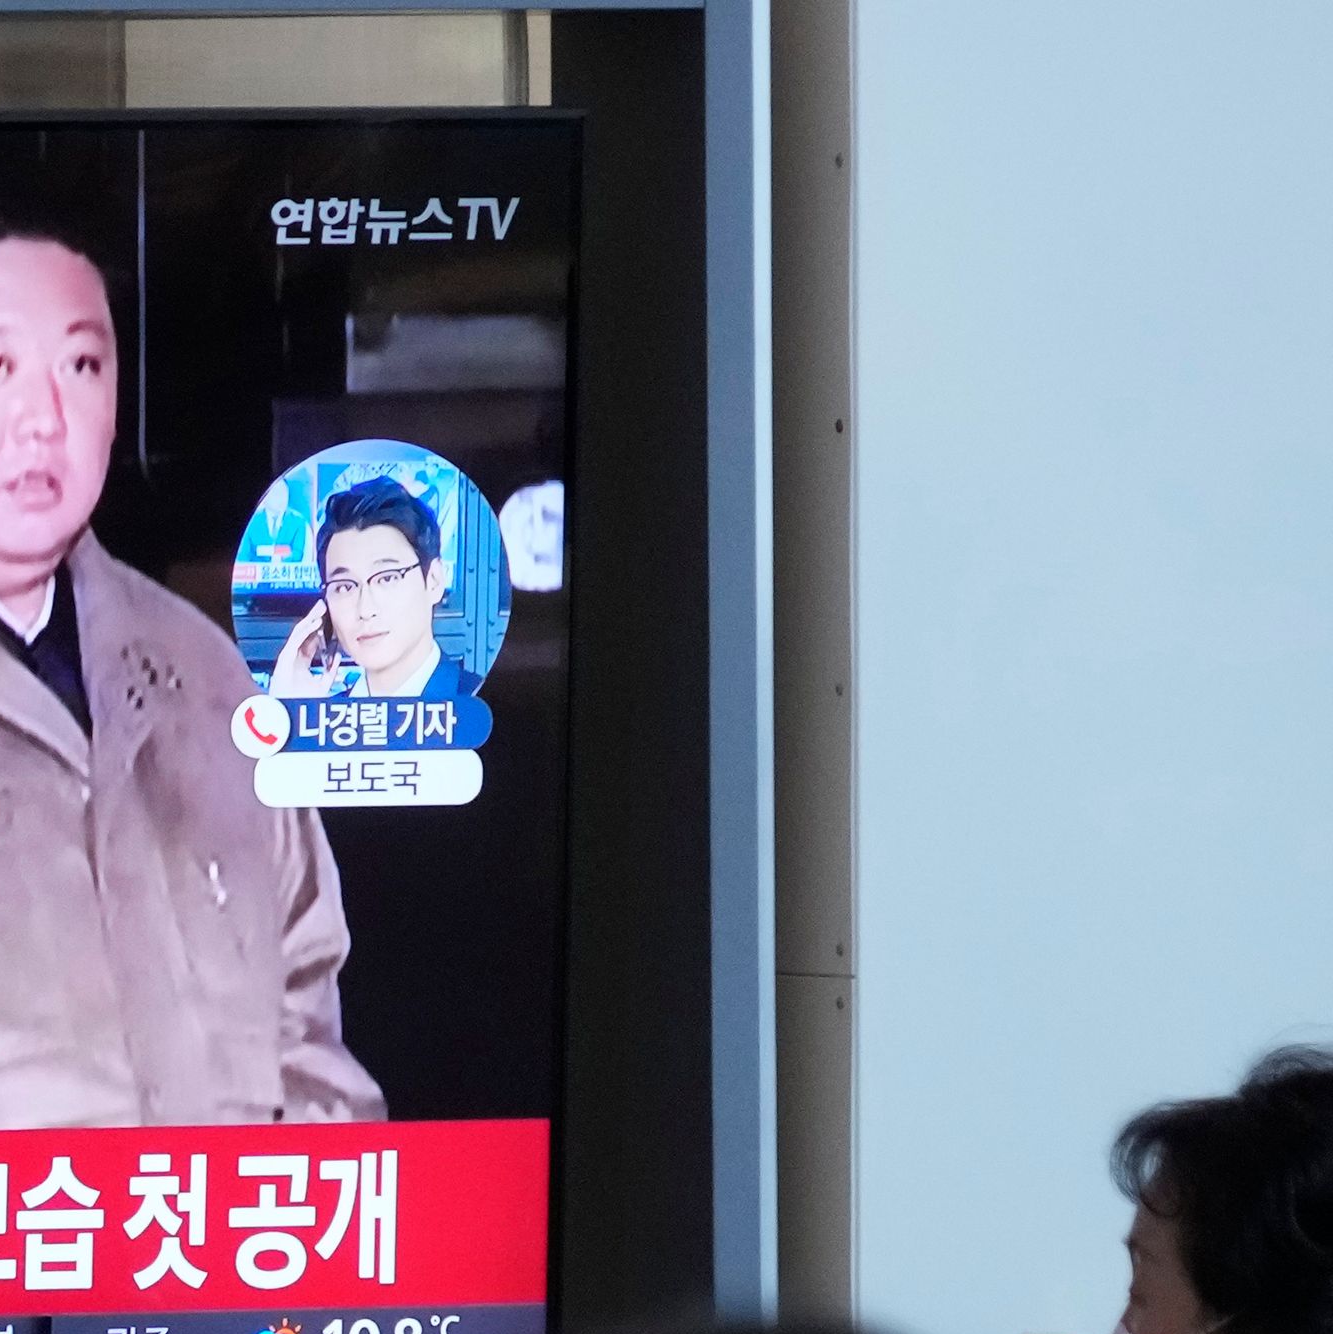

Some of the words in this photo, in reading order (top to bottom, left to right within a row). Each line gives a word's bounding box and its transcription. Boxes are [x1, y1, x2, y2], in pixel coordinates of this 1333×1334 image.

[270, 196, 521, 246] 연합뉴스TV
[297, 699, 389, 747] 나경렬
[395, 698, 458, 746] 기자
[323, 759, 422, 796] 보도국
[122, 1152, 209, 1291] 첫
[227, 1149, 398, 1291] 공개
